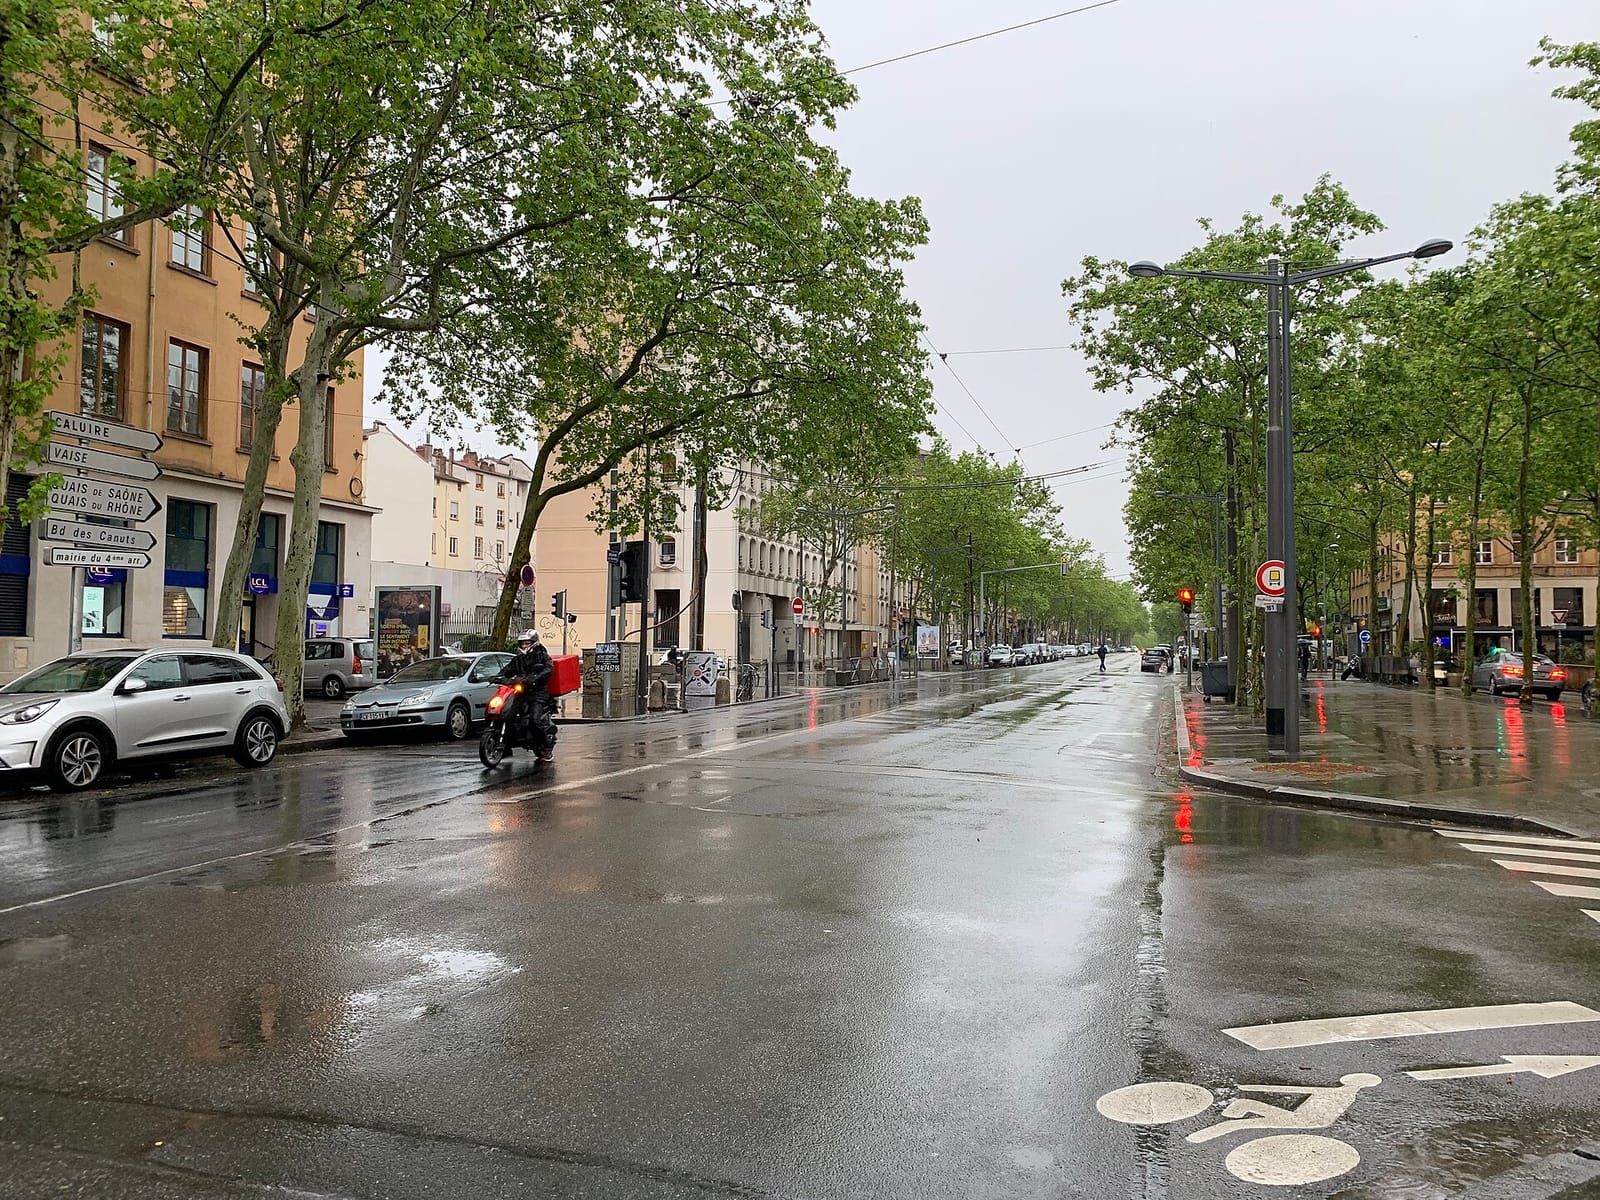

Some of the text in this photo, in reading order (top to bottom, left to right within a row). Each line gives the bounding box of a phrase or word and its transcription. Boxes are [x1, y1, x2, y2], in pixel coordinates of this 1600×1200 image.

[55, 417, 110, 438] CALUIRE
[54, 447, 88, 464] VAISE
[93, 488, 103, 497] DE
[108, 487, 144, 503] SAÔNE
[51, 492, 143, 516] QUAIS DU RHÔNE
[51, 524, 136, 545] Bd des Canuts
[56, 552, 86, 562] mairie
[90, 554, 101, 562] du
[251, 578, 267, 586] LCL
